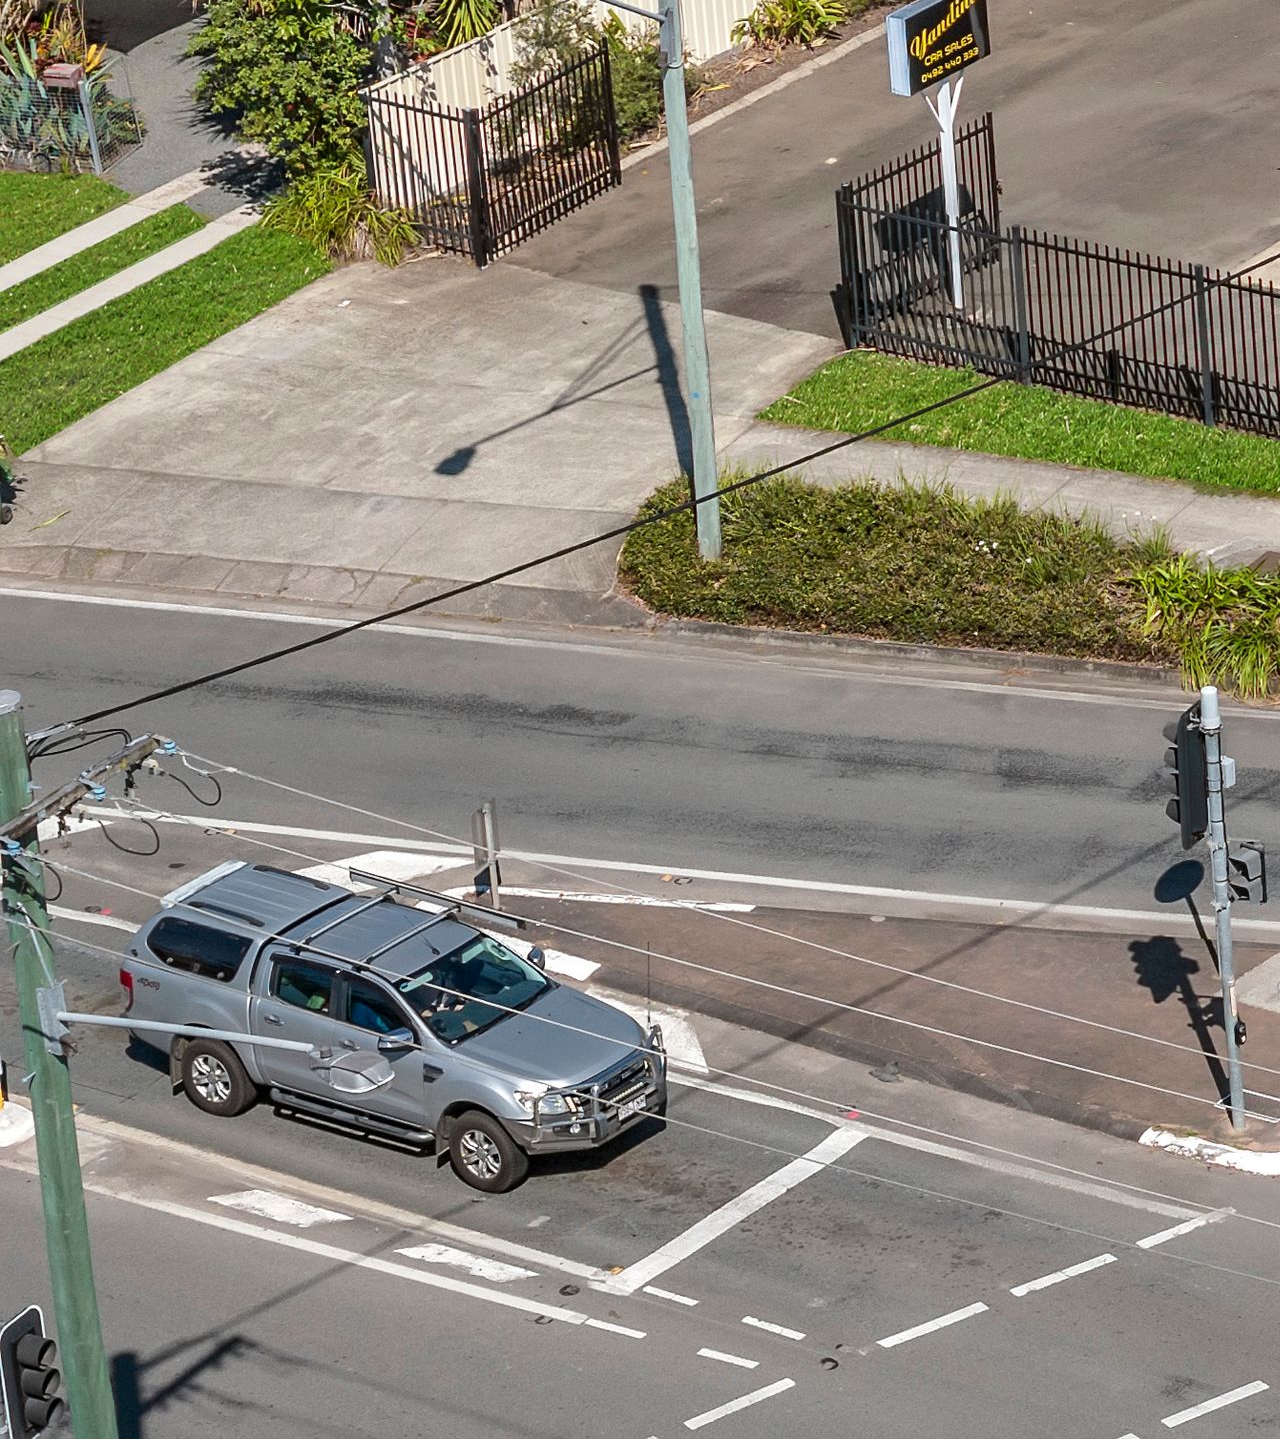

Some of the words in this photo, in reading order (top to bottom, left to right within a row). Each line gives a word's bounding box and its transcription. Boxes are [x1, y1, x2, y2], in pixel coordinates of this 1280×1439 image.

[921, 65, 944, 83] 0492
[944, 56, 962, 70] 440
[963, 47, 979, 62] 333
[924, 50, 943, 67] CAR
[944, 33, 974, 56] SALES
